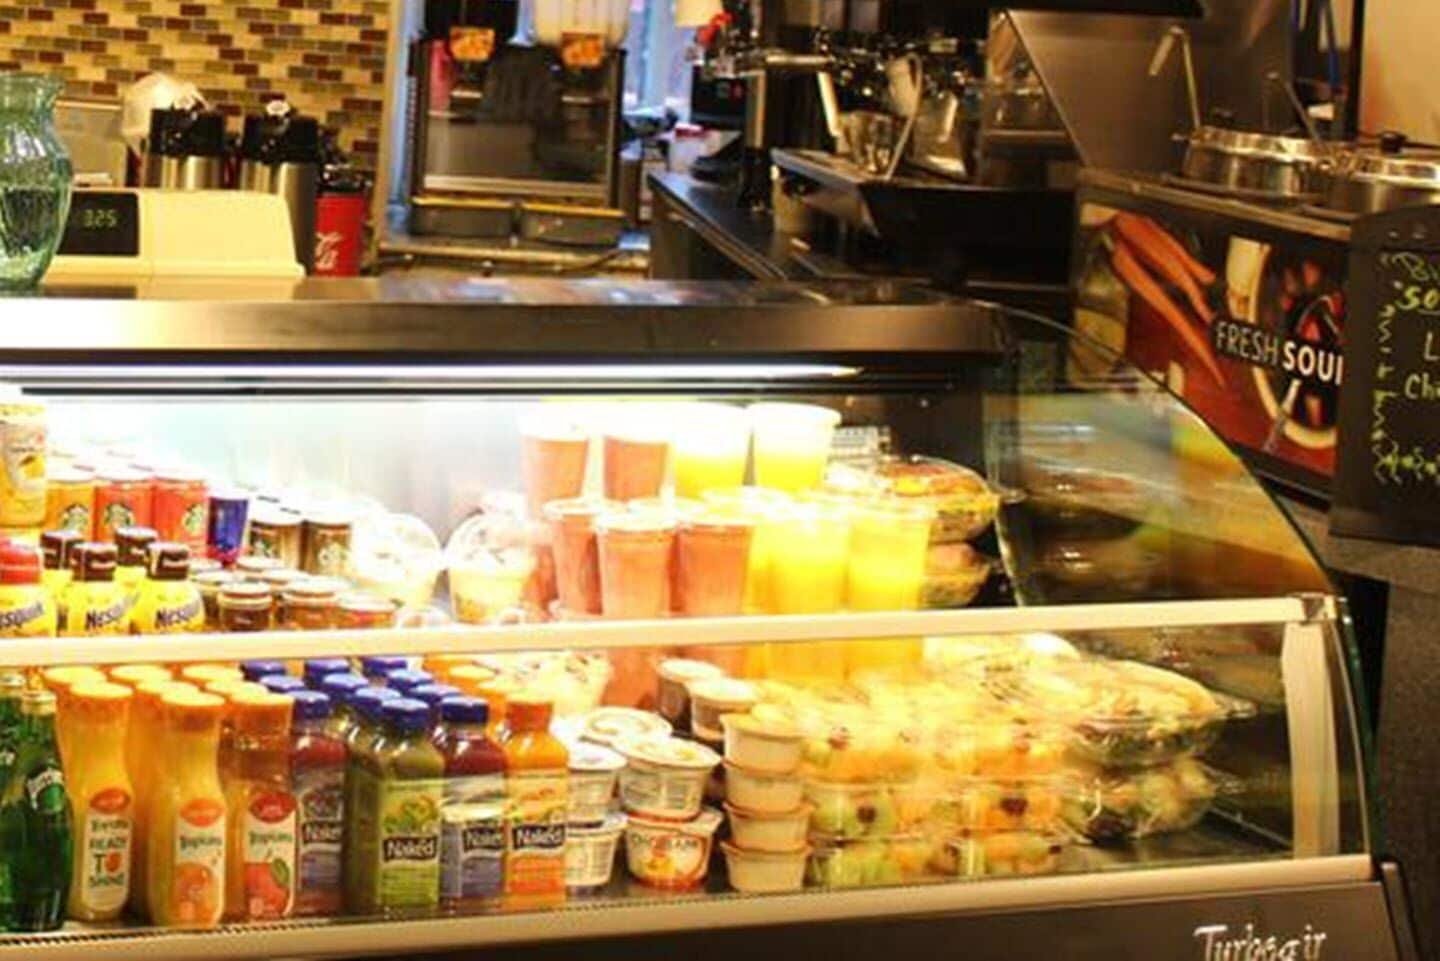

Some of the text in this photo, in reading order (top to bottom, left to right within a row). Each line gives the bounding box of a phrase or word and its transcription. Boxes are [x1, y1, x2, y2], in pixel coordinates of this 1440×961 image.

[1216, 321, 1279, 367] FRESH
[516, 825, 563, 845] Naked
[386, 838, 435, 859] Naked
